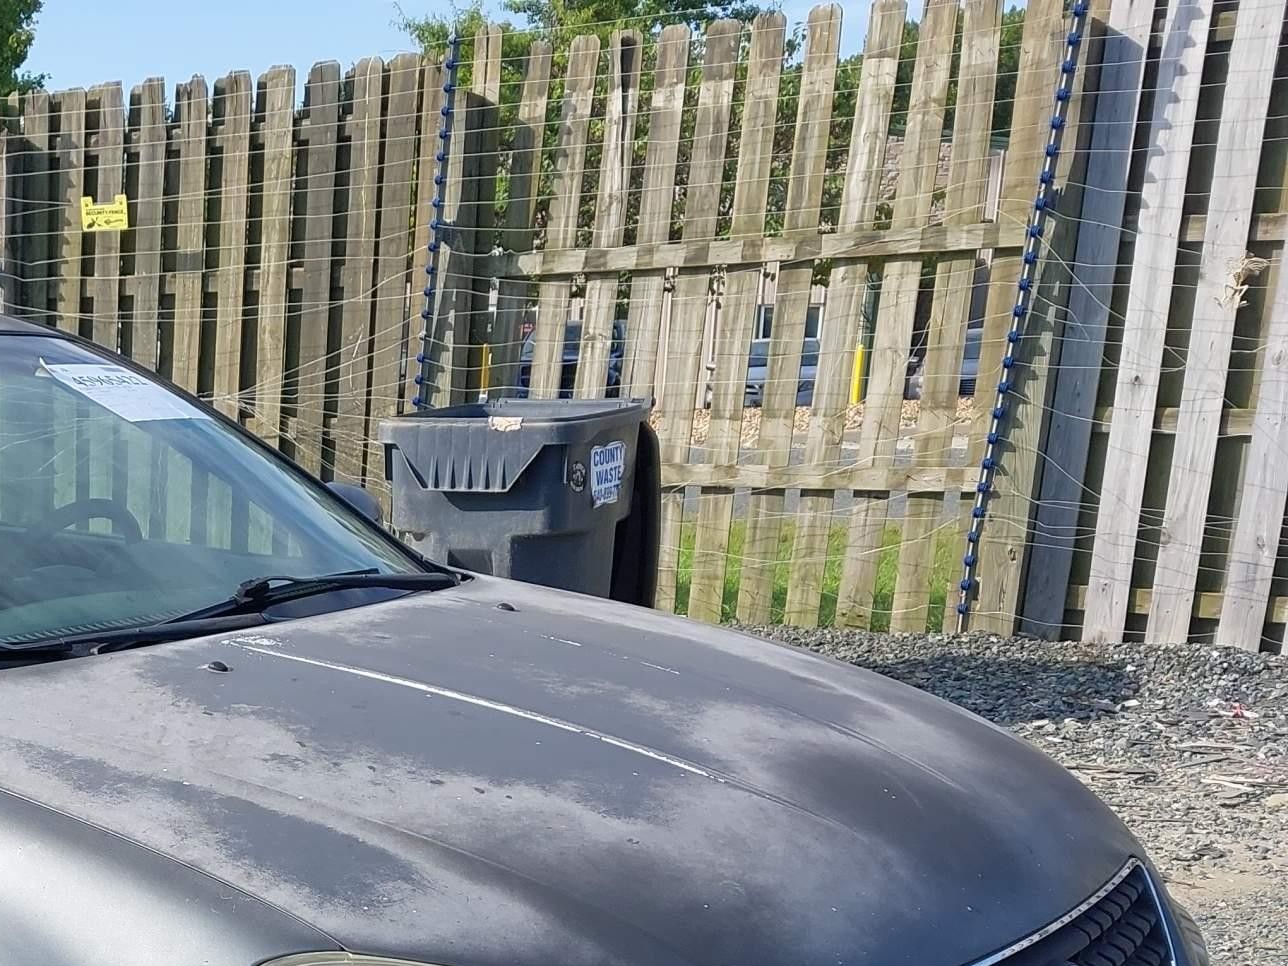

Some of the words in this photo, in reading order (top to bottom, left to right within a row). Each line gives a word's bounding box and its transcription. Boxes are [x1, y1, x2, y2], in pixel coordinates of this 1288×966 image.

[71, 375, 149, 387] 45965422
[593, 446, 622, 467] COUNTY
[595, 466, 622, 486] WASTE
